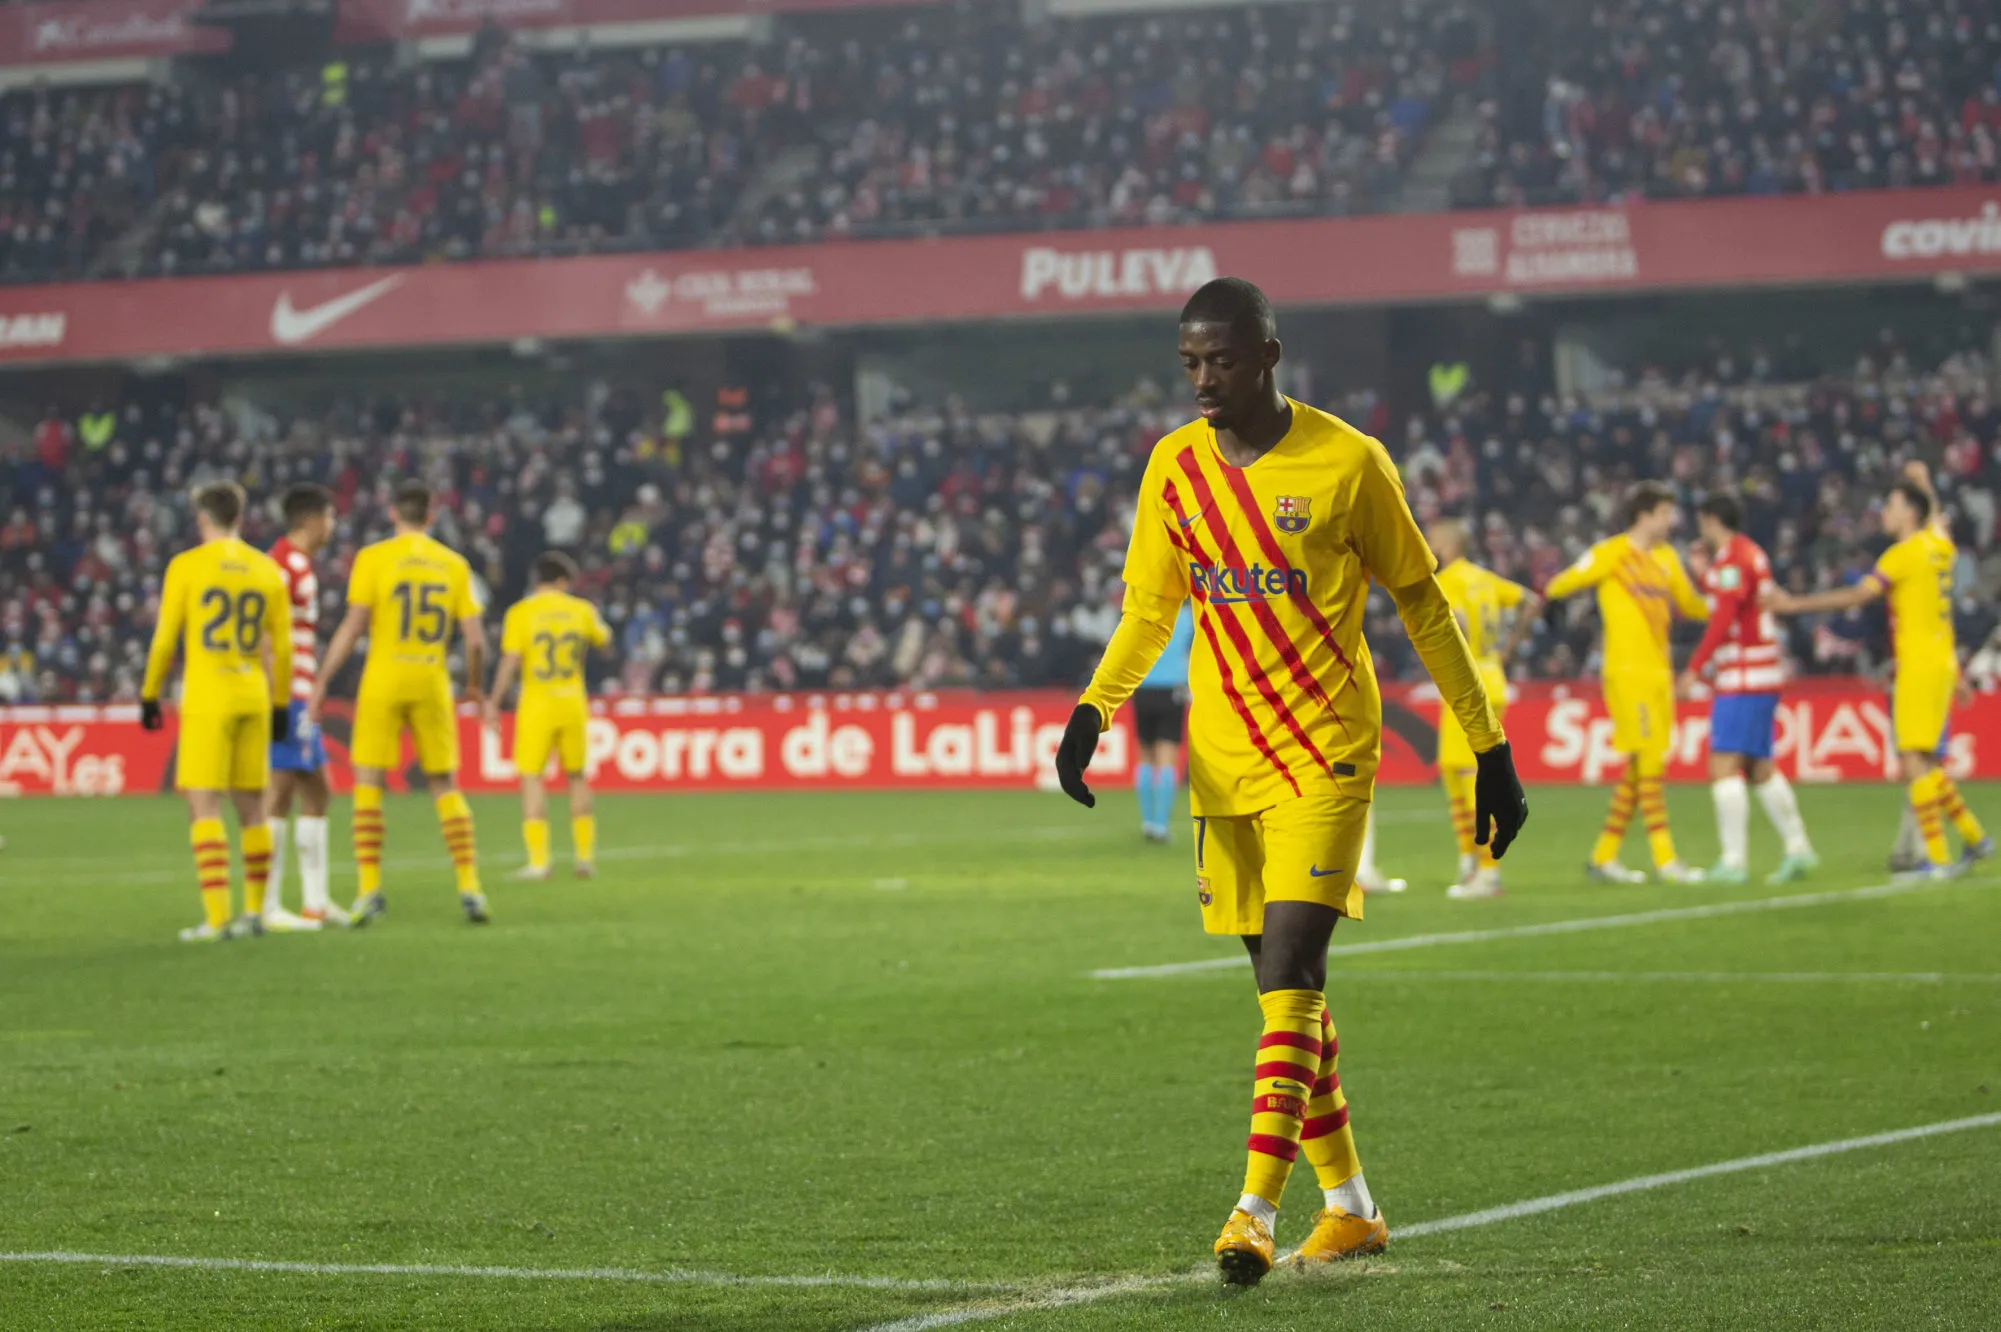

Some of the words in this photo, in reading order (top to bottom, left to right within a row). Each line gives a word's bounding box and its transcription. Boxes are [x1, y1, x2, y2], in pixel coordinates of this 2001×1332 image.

[1881, 201, 2001, 260] covi
[1020, 246, 1216, 300] PULEVA
[200, 586, 266, 656] 28
[392, 580, 450, 644] 15
[584, 716, 764, 781] Porra
[782, 709, 873, 778] de
